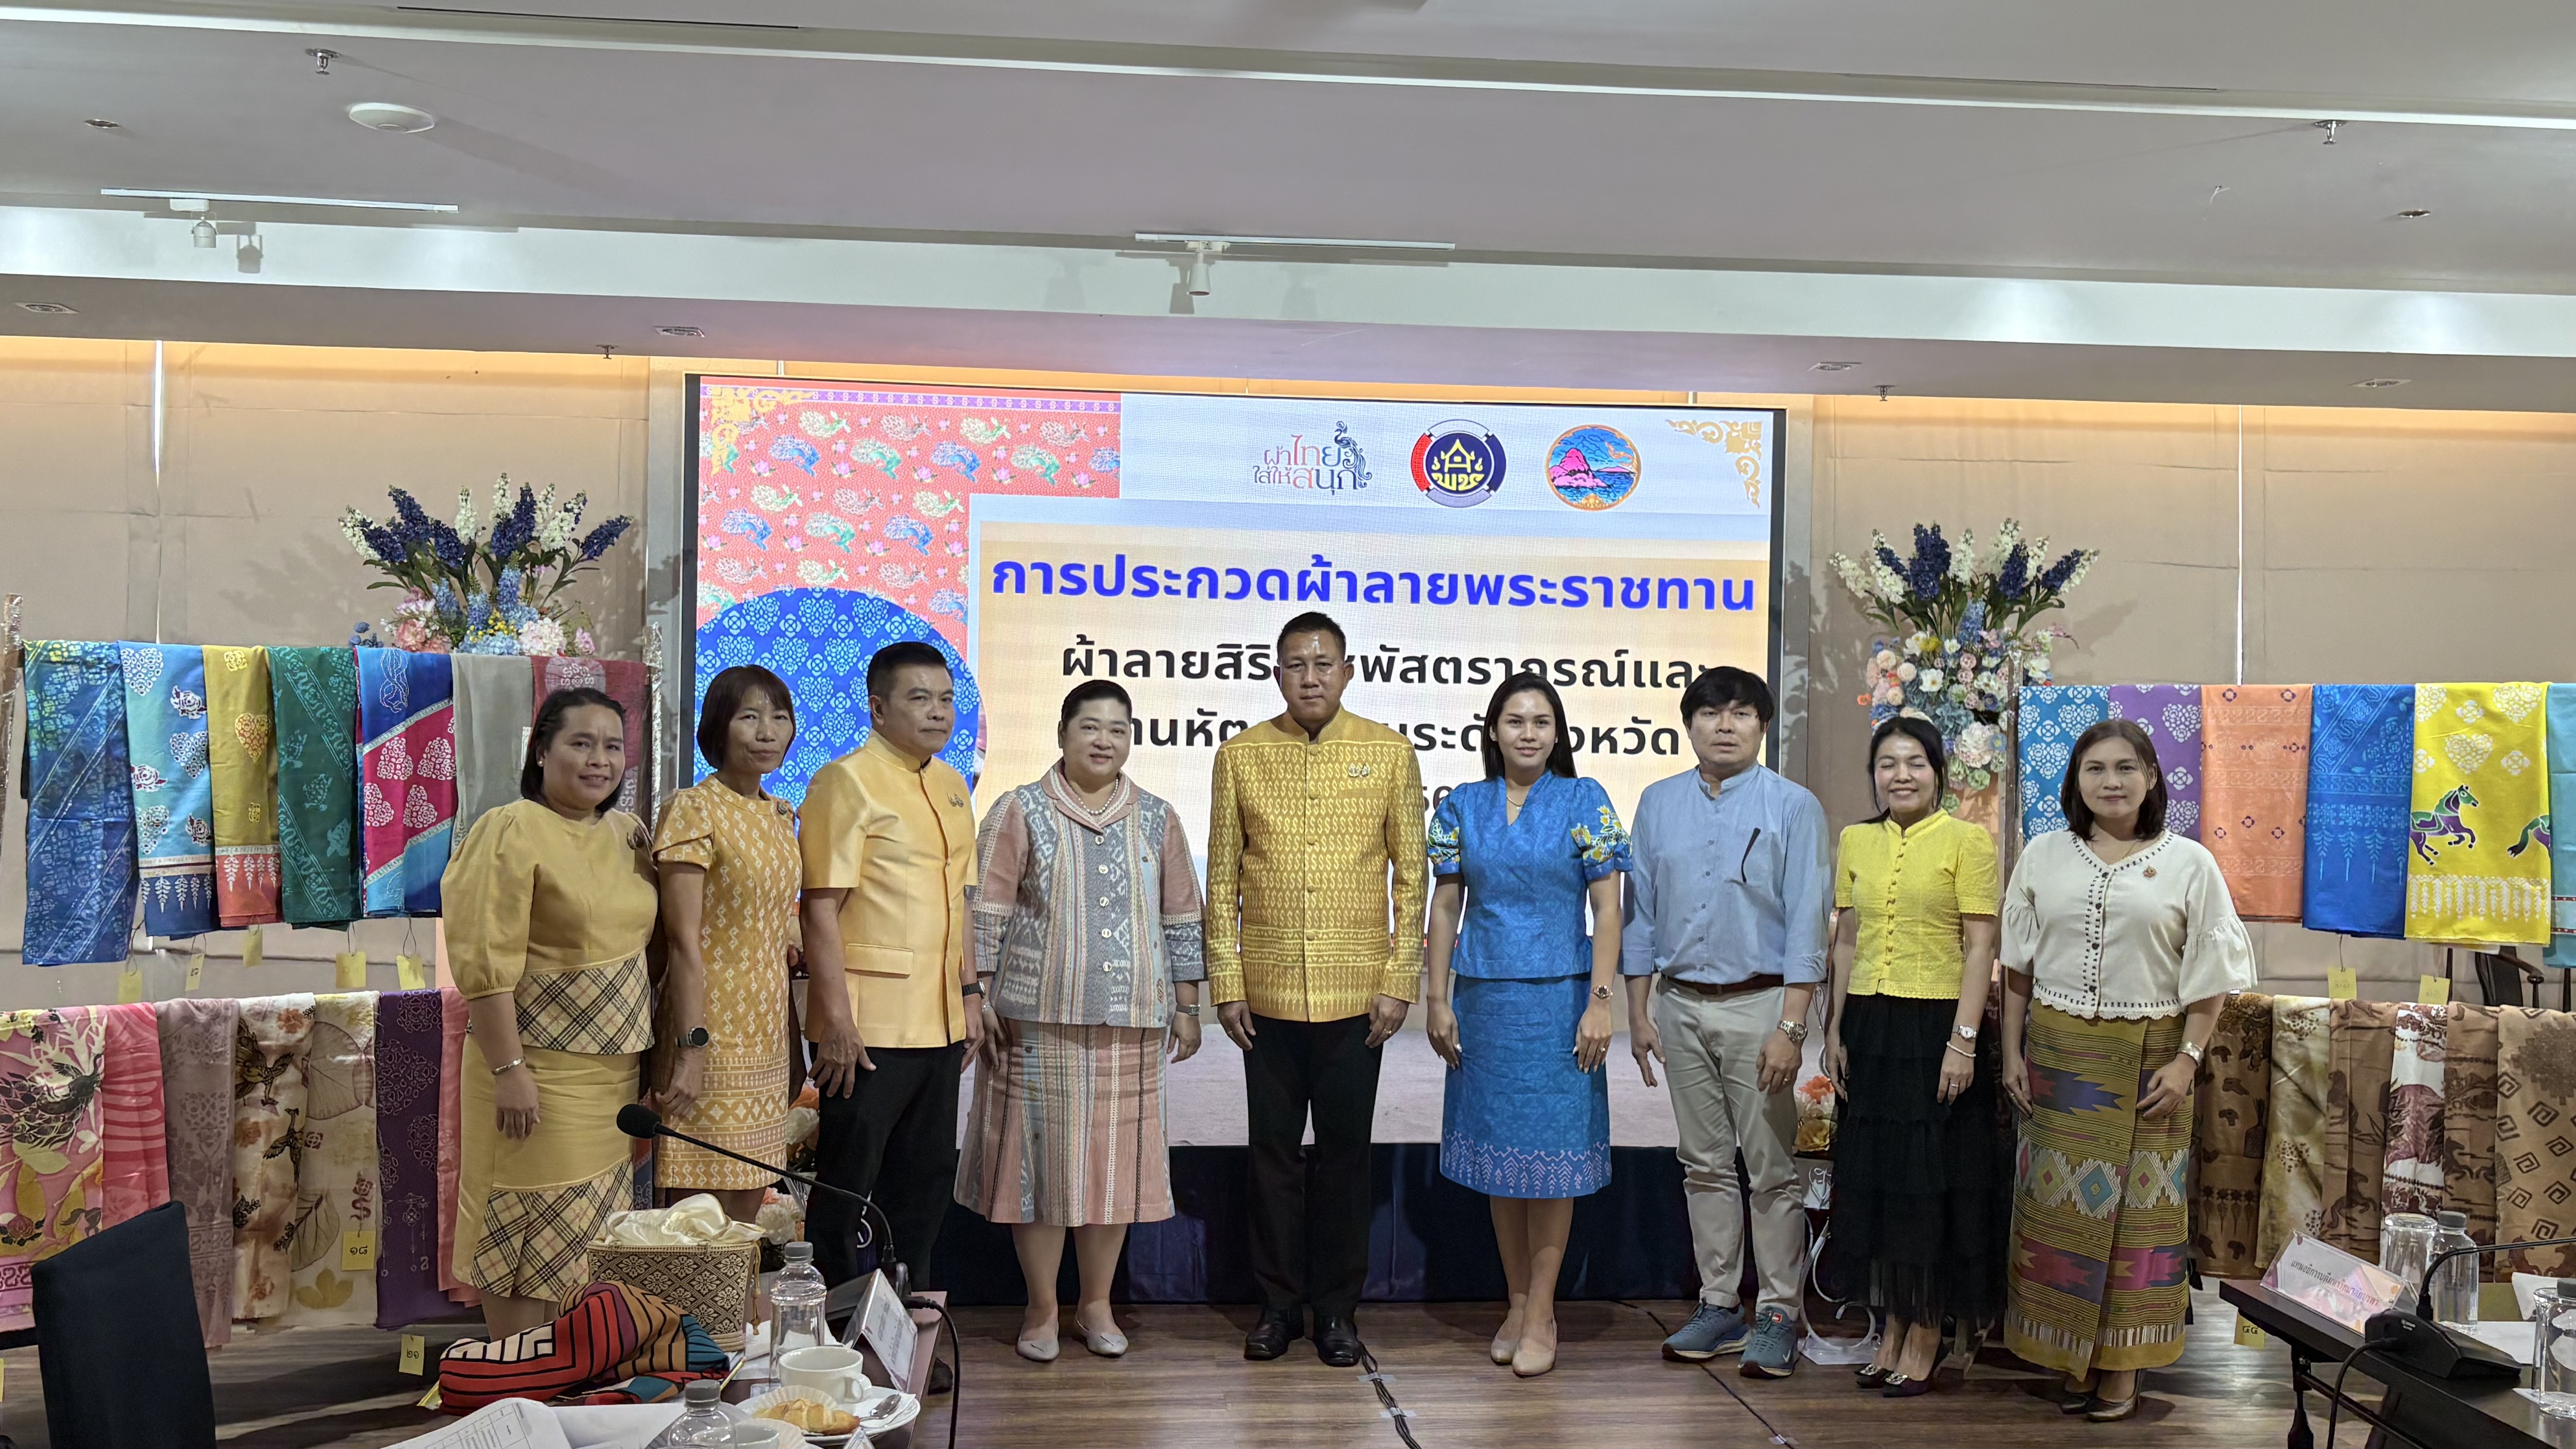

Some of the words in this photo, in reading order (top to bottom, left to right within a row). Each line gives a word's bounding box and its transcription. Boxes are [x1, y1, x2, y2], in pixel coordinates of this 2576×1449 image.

[1264, 434, 1341, 466] ผ้าไทย
[1253, 465, 1358, 496] ใส่ให้สนุก
[993, 554, 1754, 611] การประกวดผ้าลายพระราชทาน
